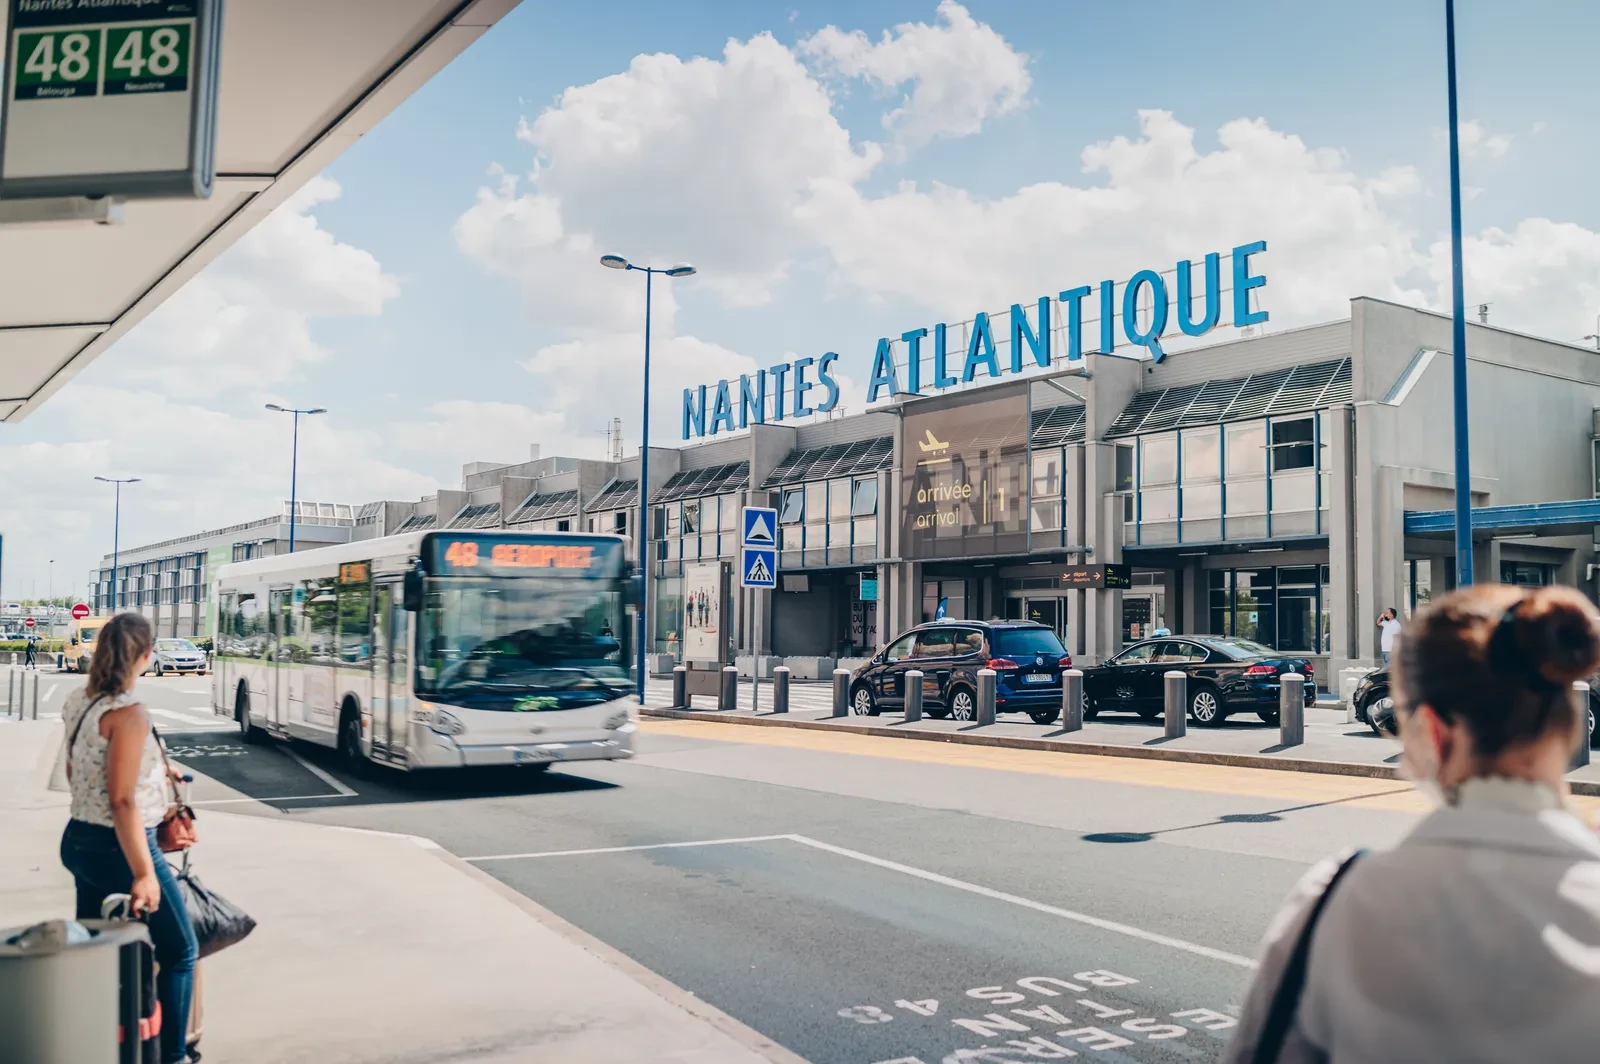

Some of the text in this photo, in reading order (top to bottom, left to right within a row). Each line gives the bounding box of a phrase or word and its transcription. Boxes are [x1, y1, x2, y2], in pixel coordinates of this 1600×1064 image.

[18, 0, 73, 12] Nantes
[24, 33, 90, 82] 48
[112, 28, 179, 77] 48
[682, 240, 1269, 440] NANTES ATLANTIQUE
[917, 479, 971, 503] arrivée
[917, 507, 959, 527] arrival
[445, 542, 479, 567] 48
[966, 970, 1140, 1004] BUS
[952, 999, 1135, 1037] TAN
